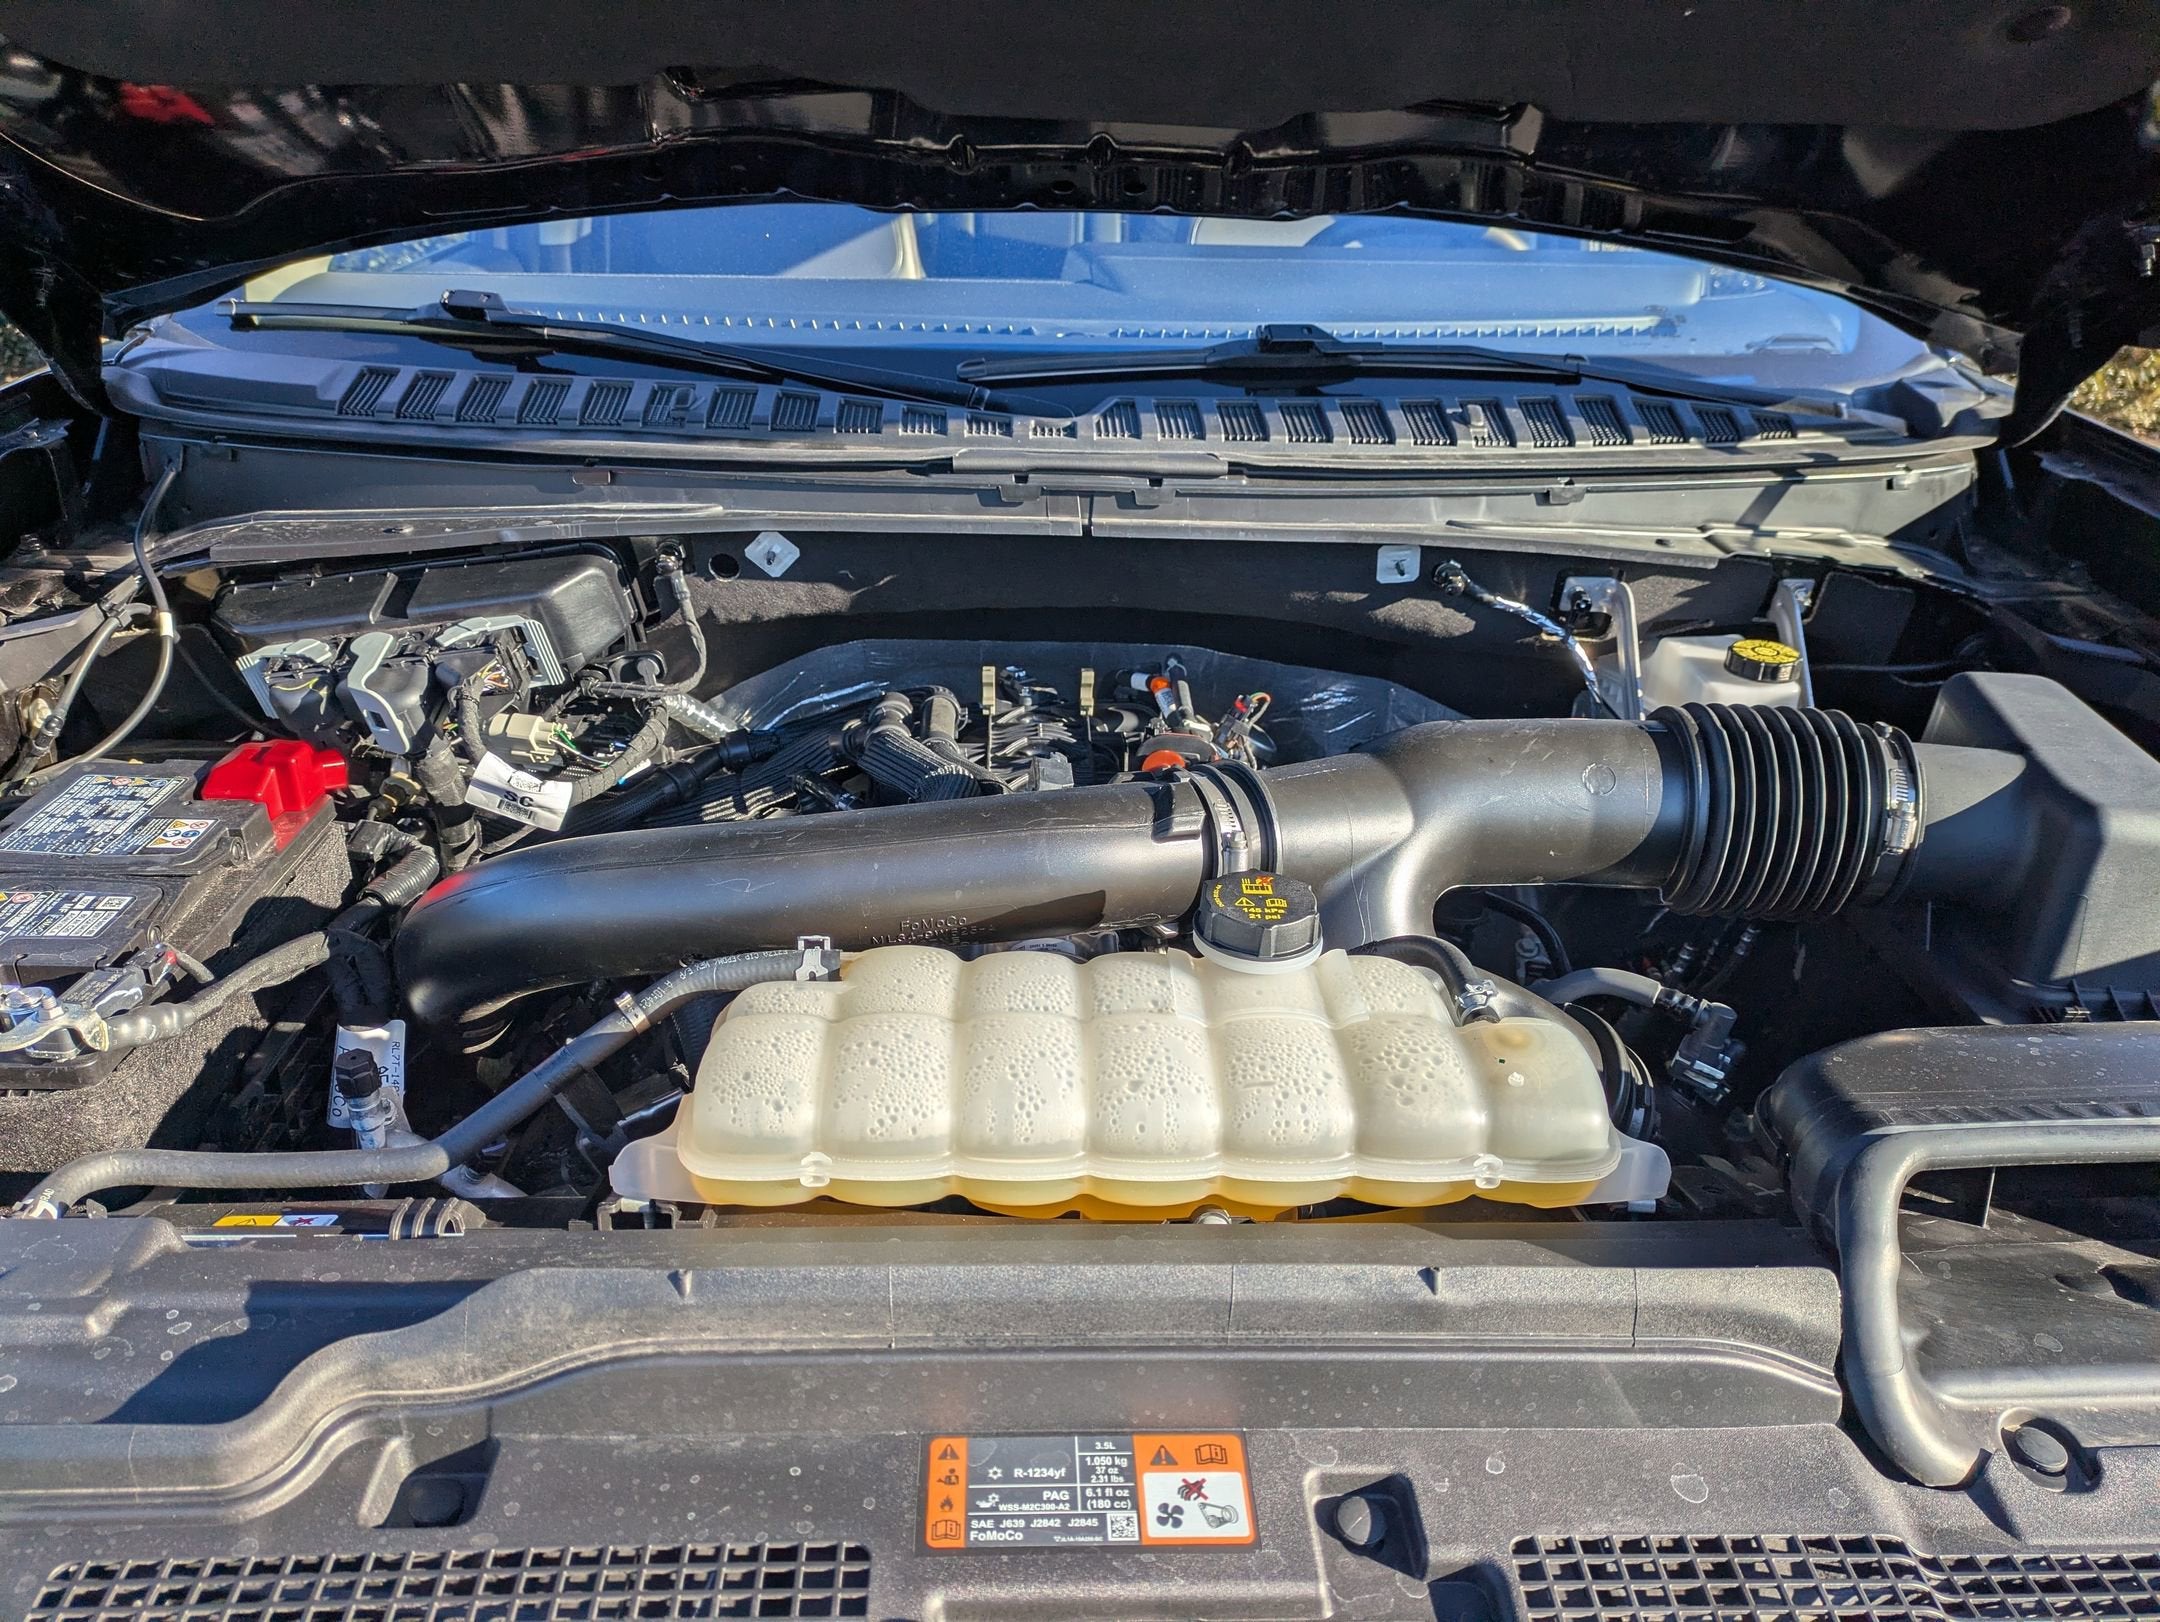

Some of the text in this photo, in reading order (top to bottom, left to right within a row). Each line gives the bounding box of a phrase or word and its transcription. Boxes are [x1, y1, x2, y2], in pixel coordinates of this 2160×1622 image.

[899, 914, 968, 932] FoMoCo
[1095, 1441, 1116, 1450] 3.5L
[1085, 1456, 1128, 1467] 1.050 kg
[1013, 1467, 1066, 1480] R-1234yf
[1090, 1475, 1125, 1483] 2.31 lbs
[1042, 1490, 1070, 1501] PAG
[1085, 1487, 1130, 1497] 6.1 fl oz
[1086, 1499, 1132, 1510] (180 cc)
[970, 1518, 1099, 1529] SAE J639 J2842 J2845
[969, 1530, 1024, 1541] FoMoCo
